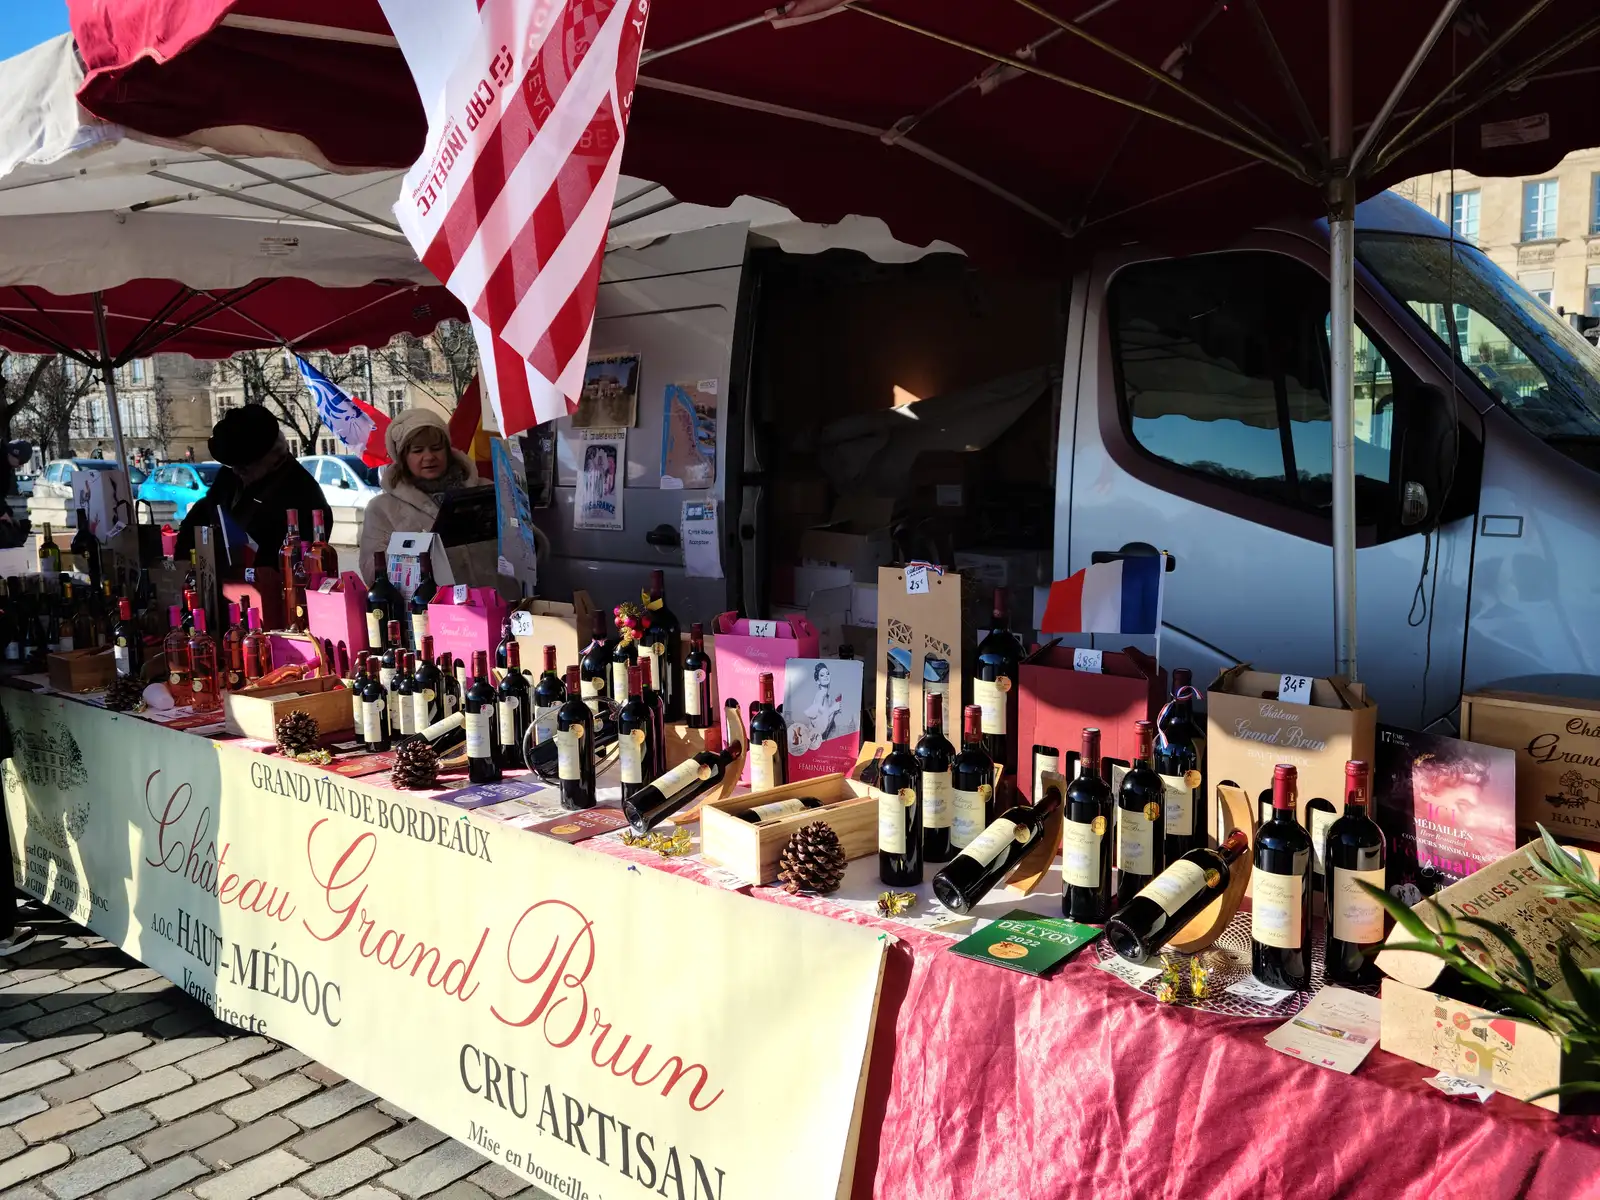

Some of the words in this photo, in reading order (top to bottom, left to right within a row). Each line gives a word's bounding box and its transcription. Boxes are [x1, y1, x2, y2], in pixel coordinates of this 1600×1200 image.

[466, 79, 496, 133] CAP
[416, 126, 468, 217] INGELEC
[1233, 717, 1283, 745] Grand
[1280, 724, 1328, 752] Brun
[1258, 702, 1300, 723] Château
[1380, 730, 1392, 743] 17
[251, 761, 311, 803] GRAND
[314, 777, 347, 814] VIN
[348, 789, 376, 823] DE
[377, 793, 493, 864] BORDEAUX
[1413, 817, 1474, 842] MÉDAILLÉS
[1401, 832, 1437, 849] CONCOURS
[1438, 843, 1471, 858] MONDIAL
[1451, 880, 1520, 918] JOYEUSES
[1508, 866, 1543, 886] FÊT
[146, 769, 296, 923] Château
[303, 817, 491, 1003] Grand
[490, 899, 725, 1112] Brun
[999, 920, 1026, 932] DE
[1025, 927, 1078, 946] LYON
[1005, 934, 1041, 948] 2022
[151, 912, 174, 943] A.O.C.
[176, 908, 342, 1028] HAUT-MÉDOC
[182, 967, 212, 1006] Vente
[213, 998, 268, 1035] directe
[459, 1043, 529, 1120] CRU
[536, 1083, 726, 1200] ARTISAN
[467, 1119, 501, 1156] Mise
[505, 1148, 522, 1168] en
[526, 1153, 589, 1200] bouteille
